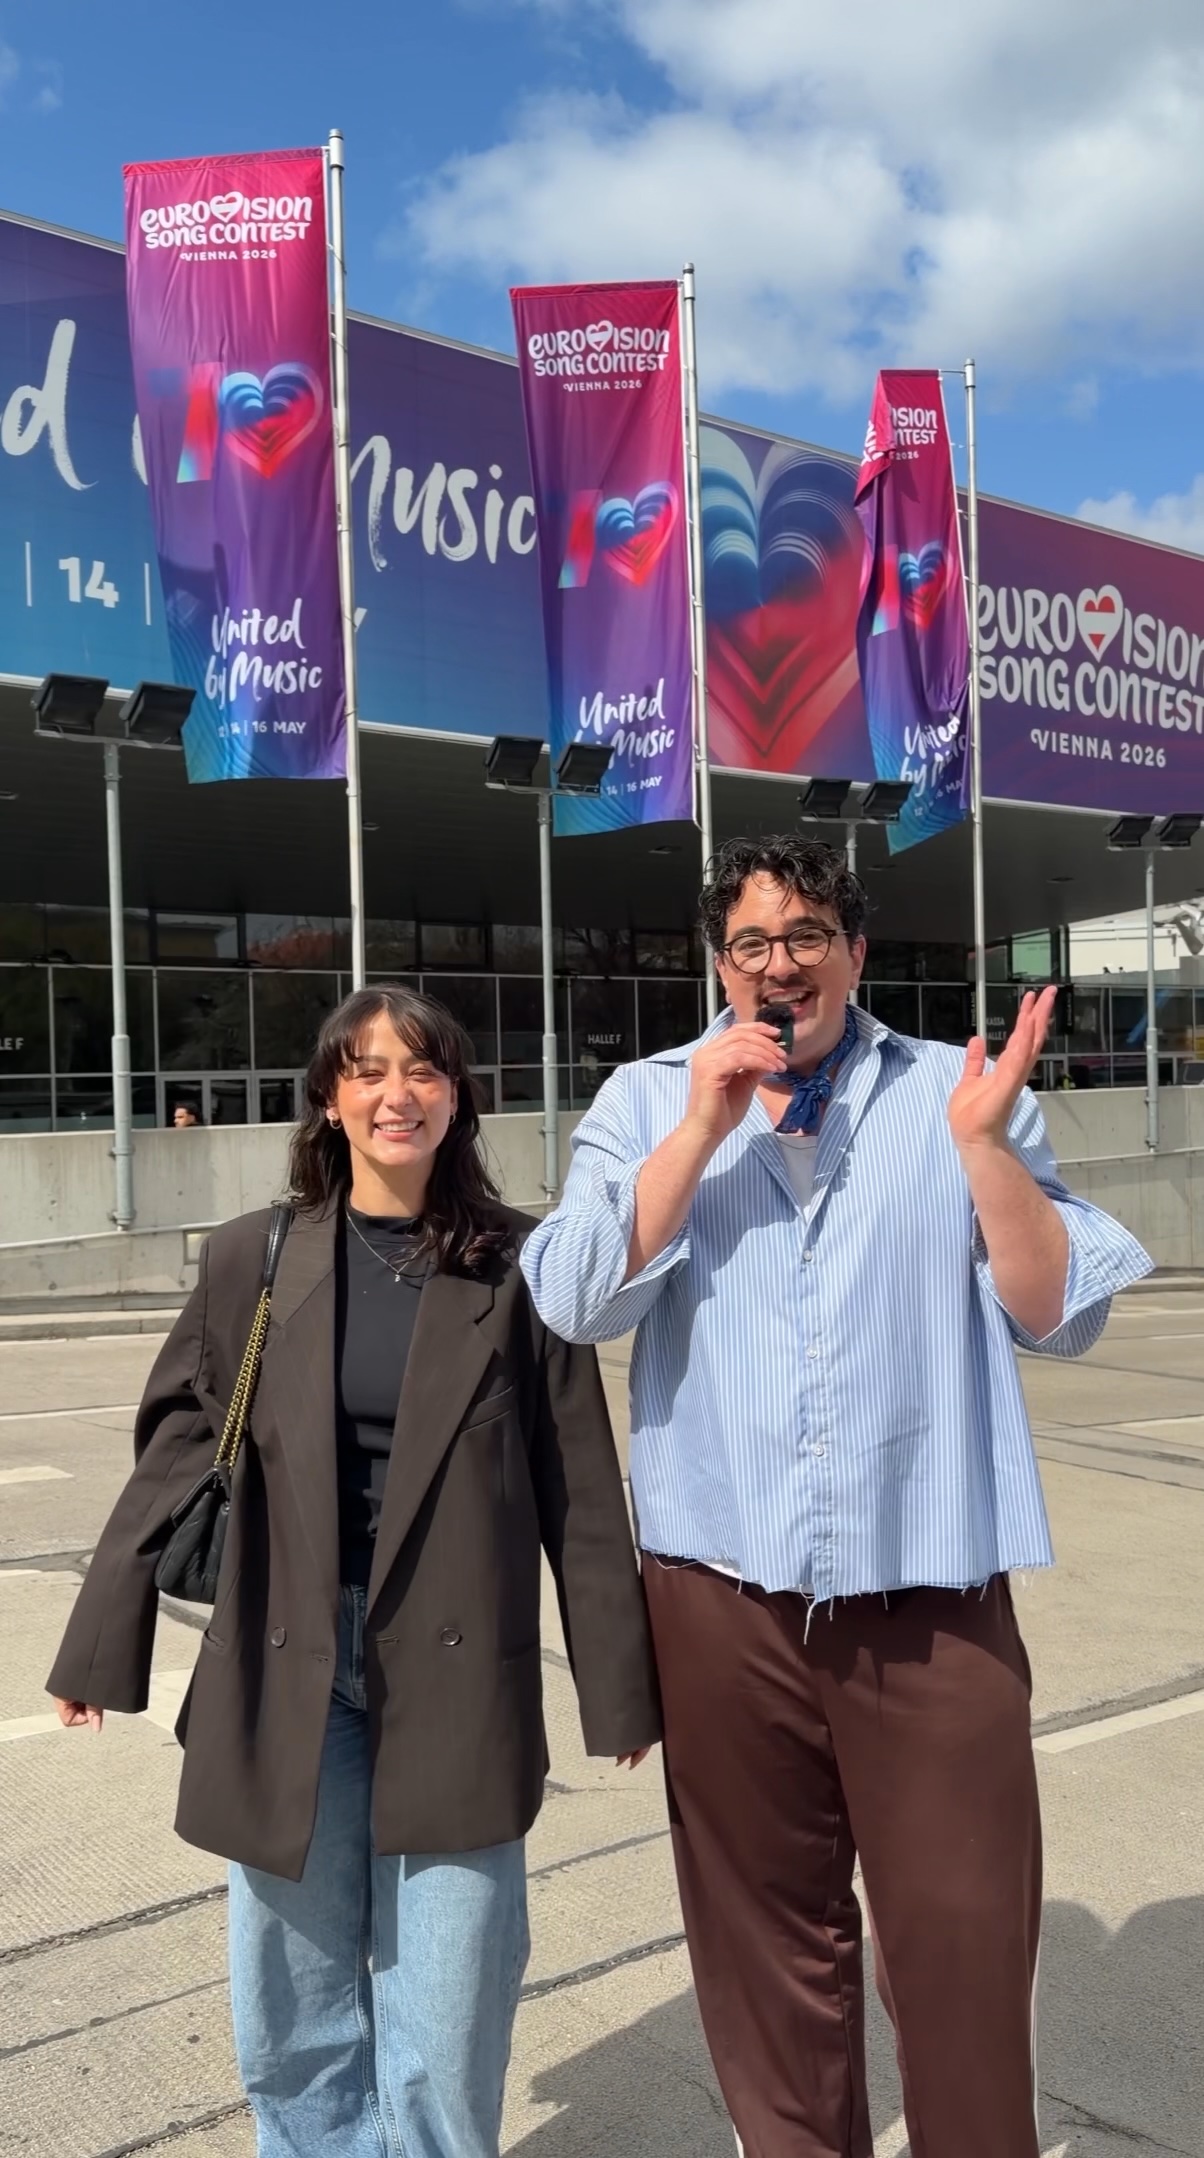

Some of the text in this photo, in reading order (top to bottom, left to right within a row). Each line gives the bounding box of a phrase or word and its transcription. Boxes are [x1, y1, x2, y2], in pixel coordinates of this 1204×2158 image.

[145, 221, 310, 249] SONG CONTEST
[180, 249, 277, 262] VIENNA 2026
[534, 352, 668, 377] SONG CONTEST
[563, 379, 643, 392] VIENNA 2026
[58, 556, 120, 609] 14
[211, 597, 307, 660] United
[205, 651, 323, 710] by Music
[979, 655, 1071, 712] SONG
[579, 677, 666, 736] United
[251, 720, 268, 733] 16
[273, 721, 307, 734] MAY
[1030, 728, 1167, 768] VIENNA 2026
[627, 781, 638, 793] 16
[640, 775, 663, 790] MAY
[15, 1037, 24, 1050] F
[588, 1033, 615, 1045] HALLE
